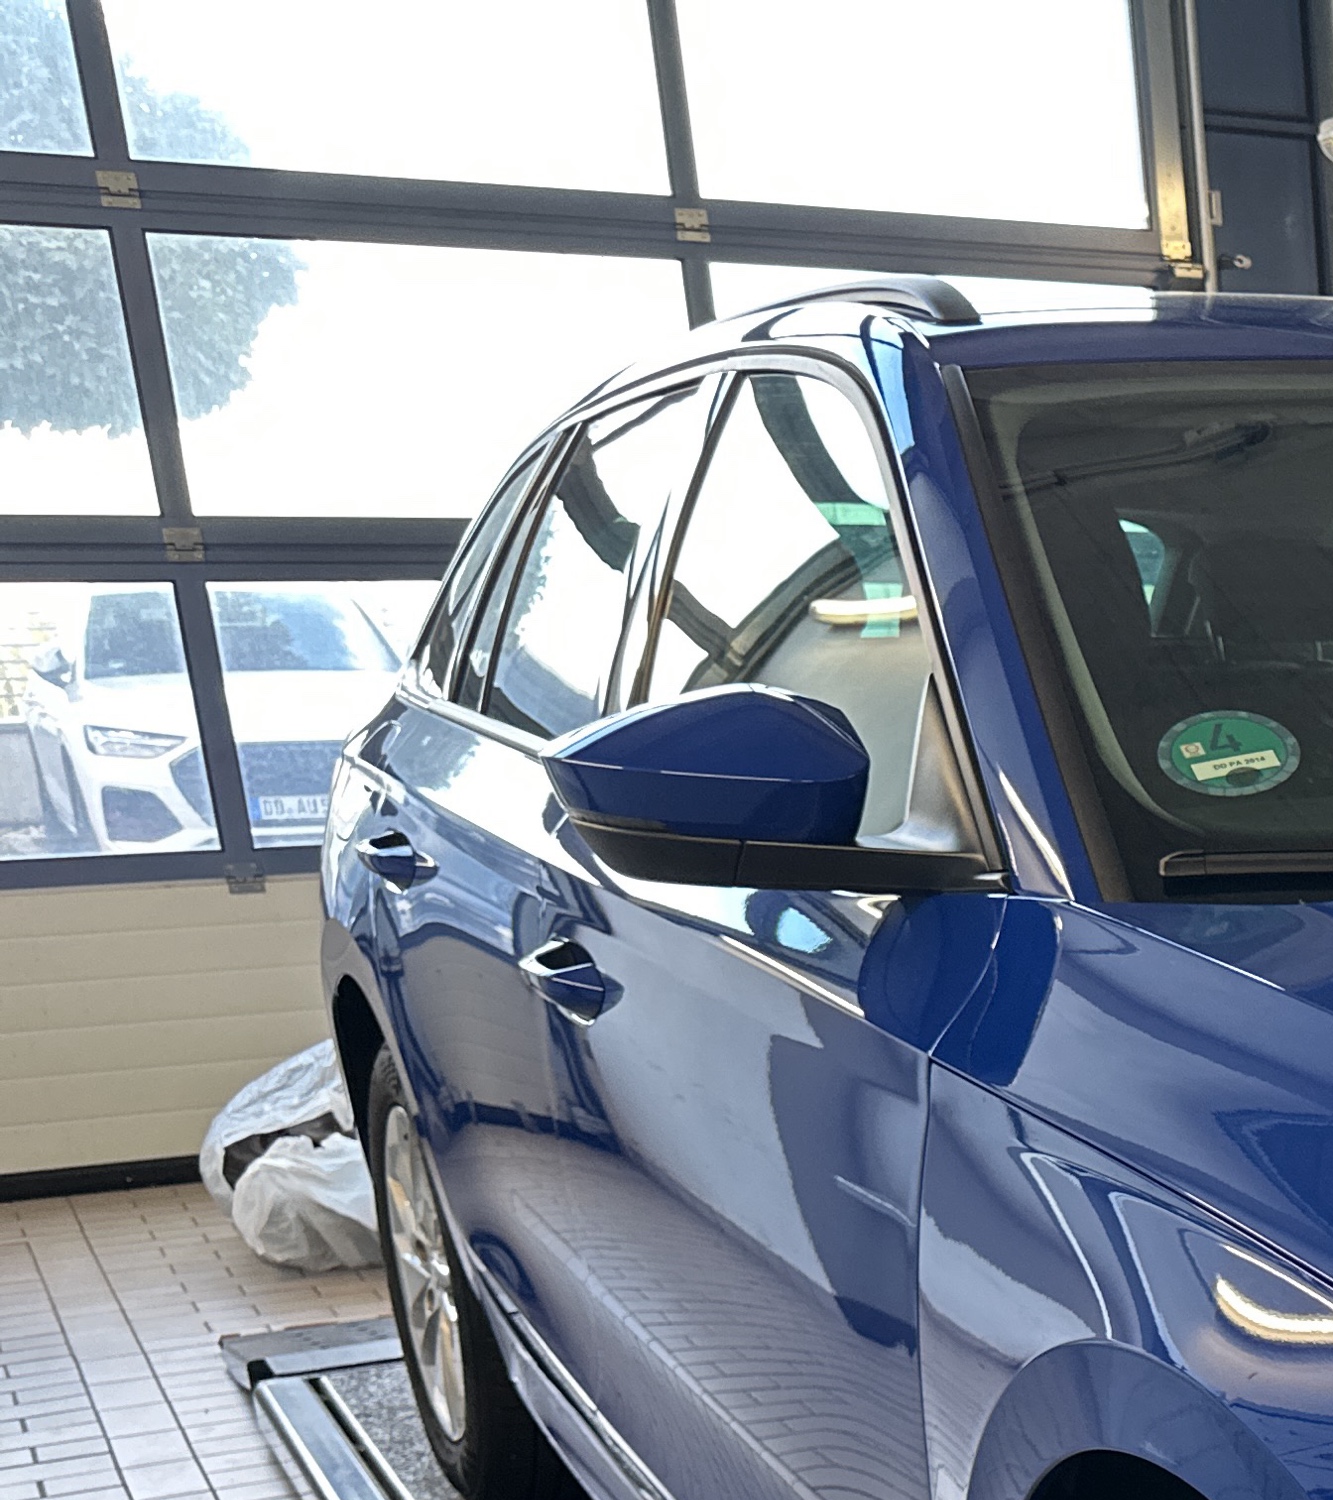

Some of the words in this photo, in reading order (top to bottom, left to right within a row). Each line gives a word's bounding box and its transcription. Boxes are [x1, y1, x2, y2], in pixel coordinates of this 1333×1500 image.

[1210, 724, 1242, 752] 4
[1213, 763, 1227, 771] DD
[263, 799, 285, 816] DD
